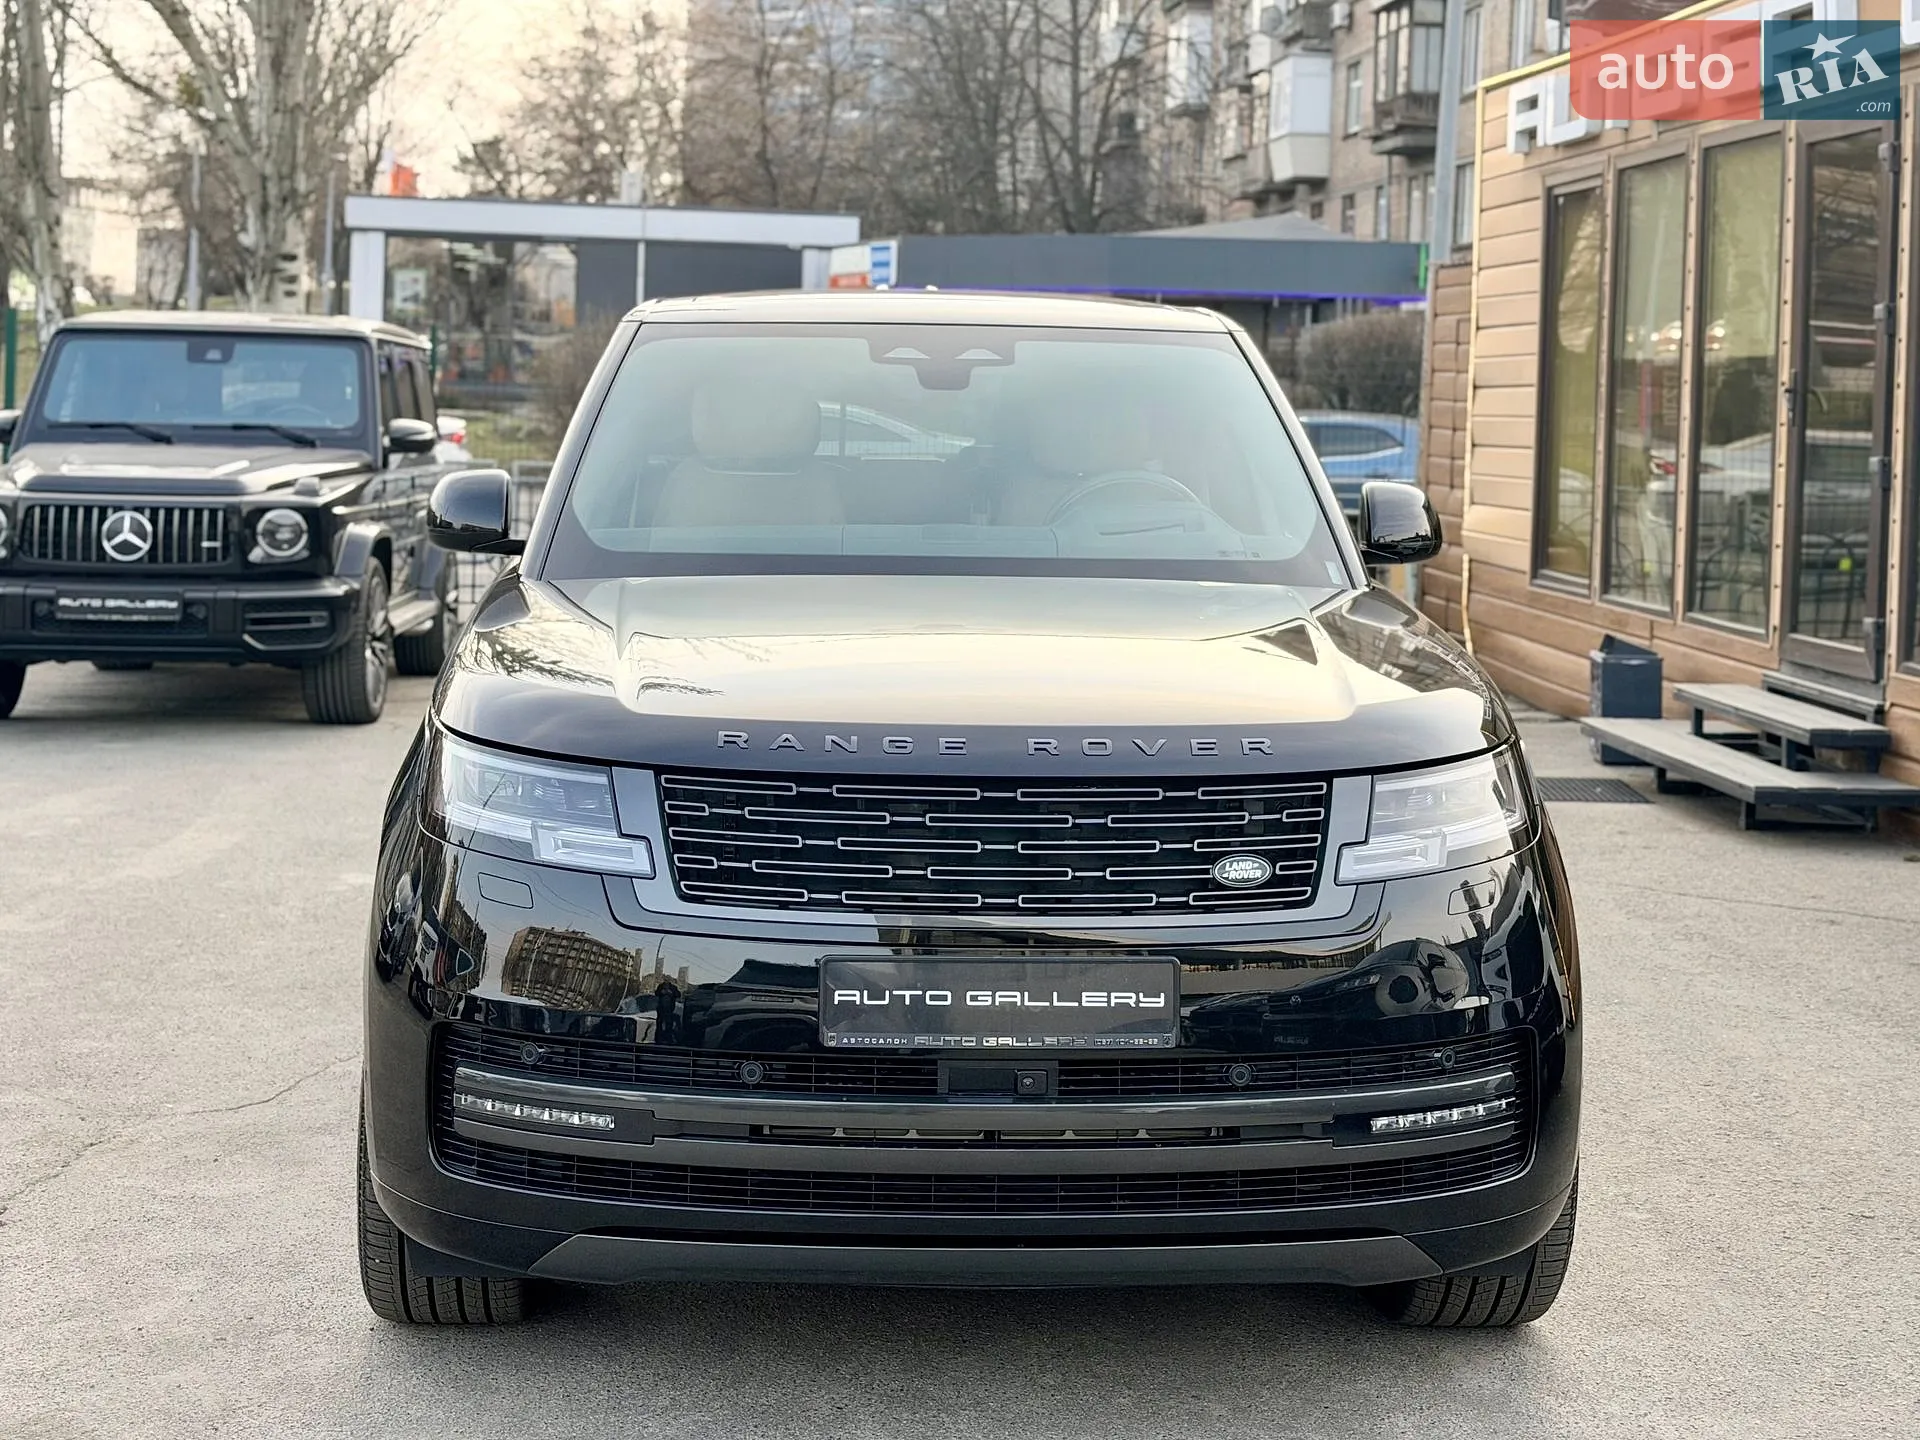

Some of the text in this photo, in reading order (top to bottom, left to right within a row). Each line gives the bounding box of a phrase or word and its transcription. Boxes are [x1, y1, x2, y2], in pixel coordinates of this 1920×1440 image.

[717, 730, 1275, 756] RANGE ROVER
[1225, 861, 1254, 871] LAND
[1228, 869, 1262, 880] ROVER
[833, 989, 1165, 1008] AUTO GALLERY
[842, 1037, 908, 1045] АВТОСАЛОН
[914, 1036, 976, 1046] AUTO
